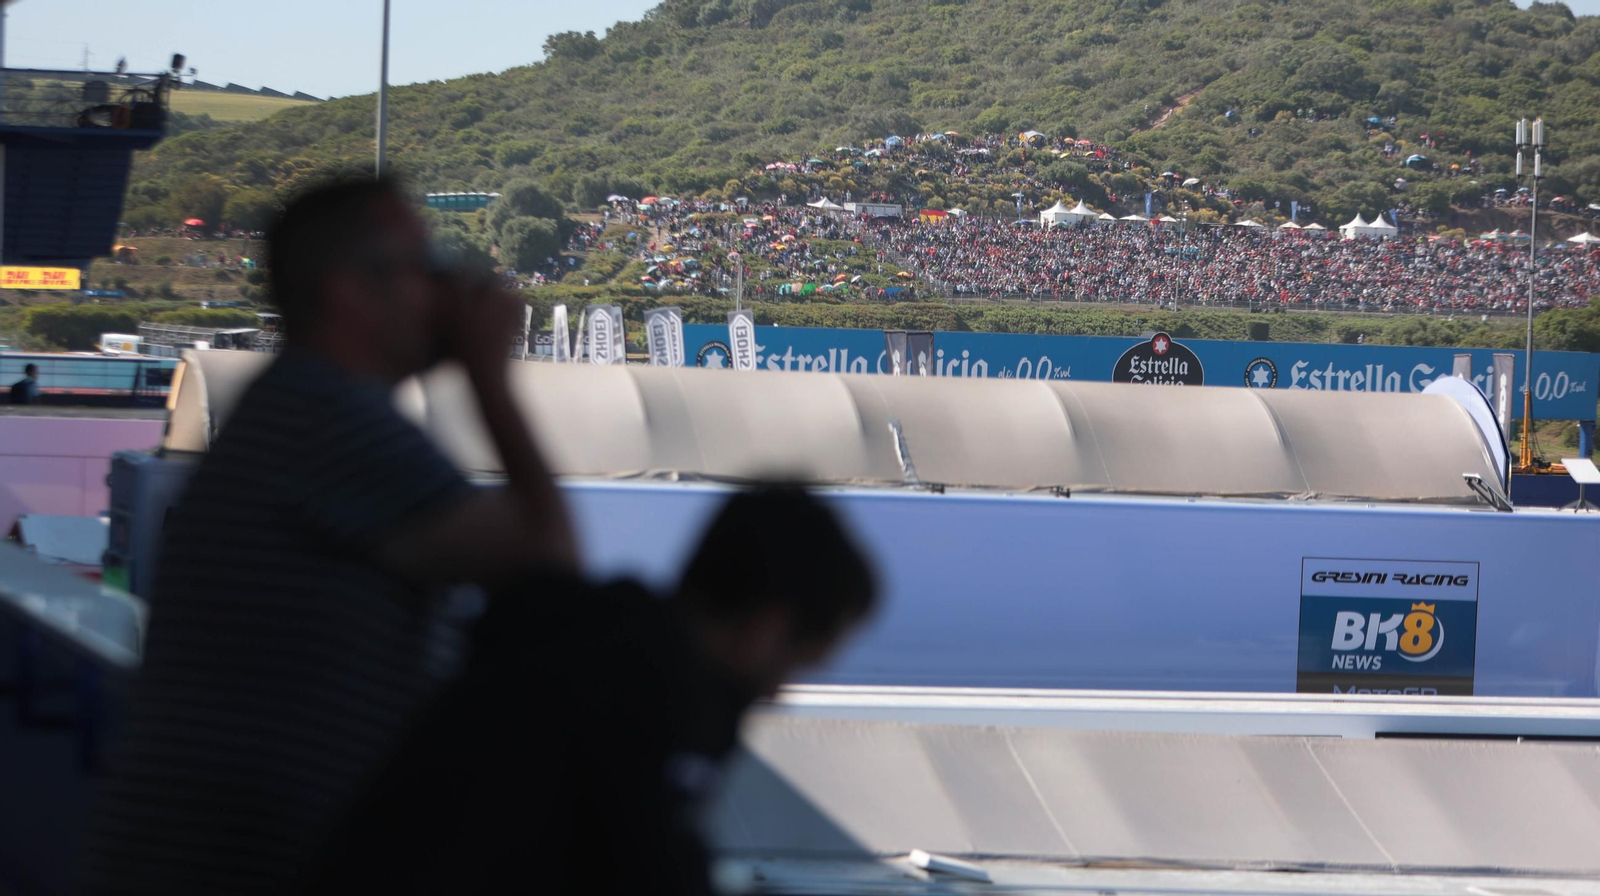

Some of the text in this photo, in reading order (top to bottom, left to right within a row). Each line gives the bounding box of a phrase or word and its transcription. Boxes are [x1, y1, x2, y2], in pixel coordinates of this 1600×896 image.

[755, 344, 868, 374] strella
[1016, 355, 1053, 380] 00
[1128, 355, 1189, 375] Estrella
[1287, 359, 1402, 393] Estrella
[1535, 371, 1569, 401] 0,0
[1311, 571, 1469, 587] GRESINI RACING
[1330, 610, 1436, 656] BK8
[1331, 654, 1382, 671] NEWS
